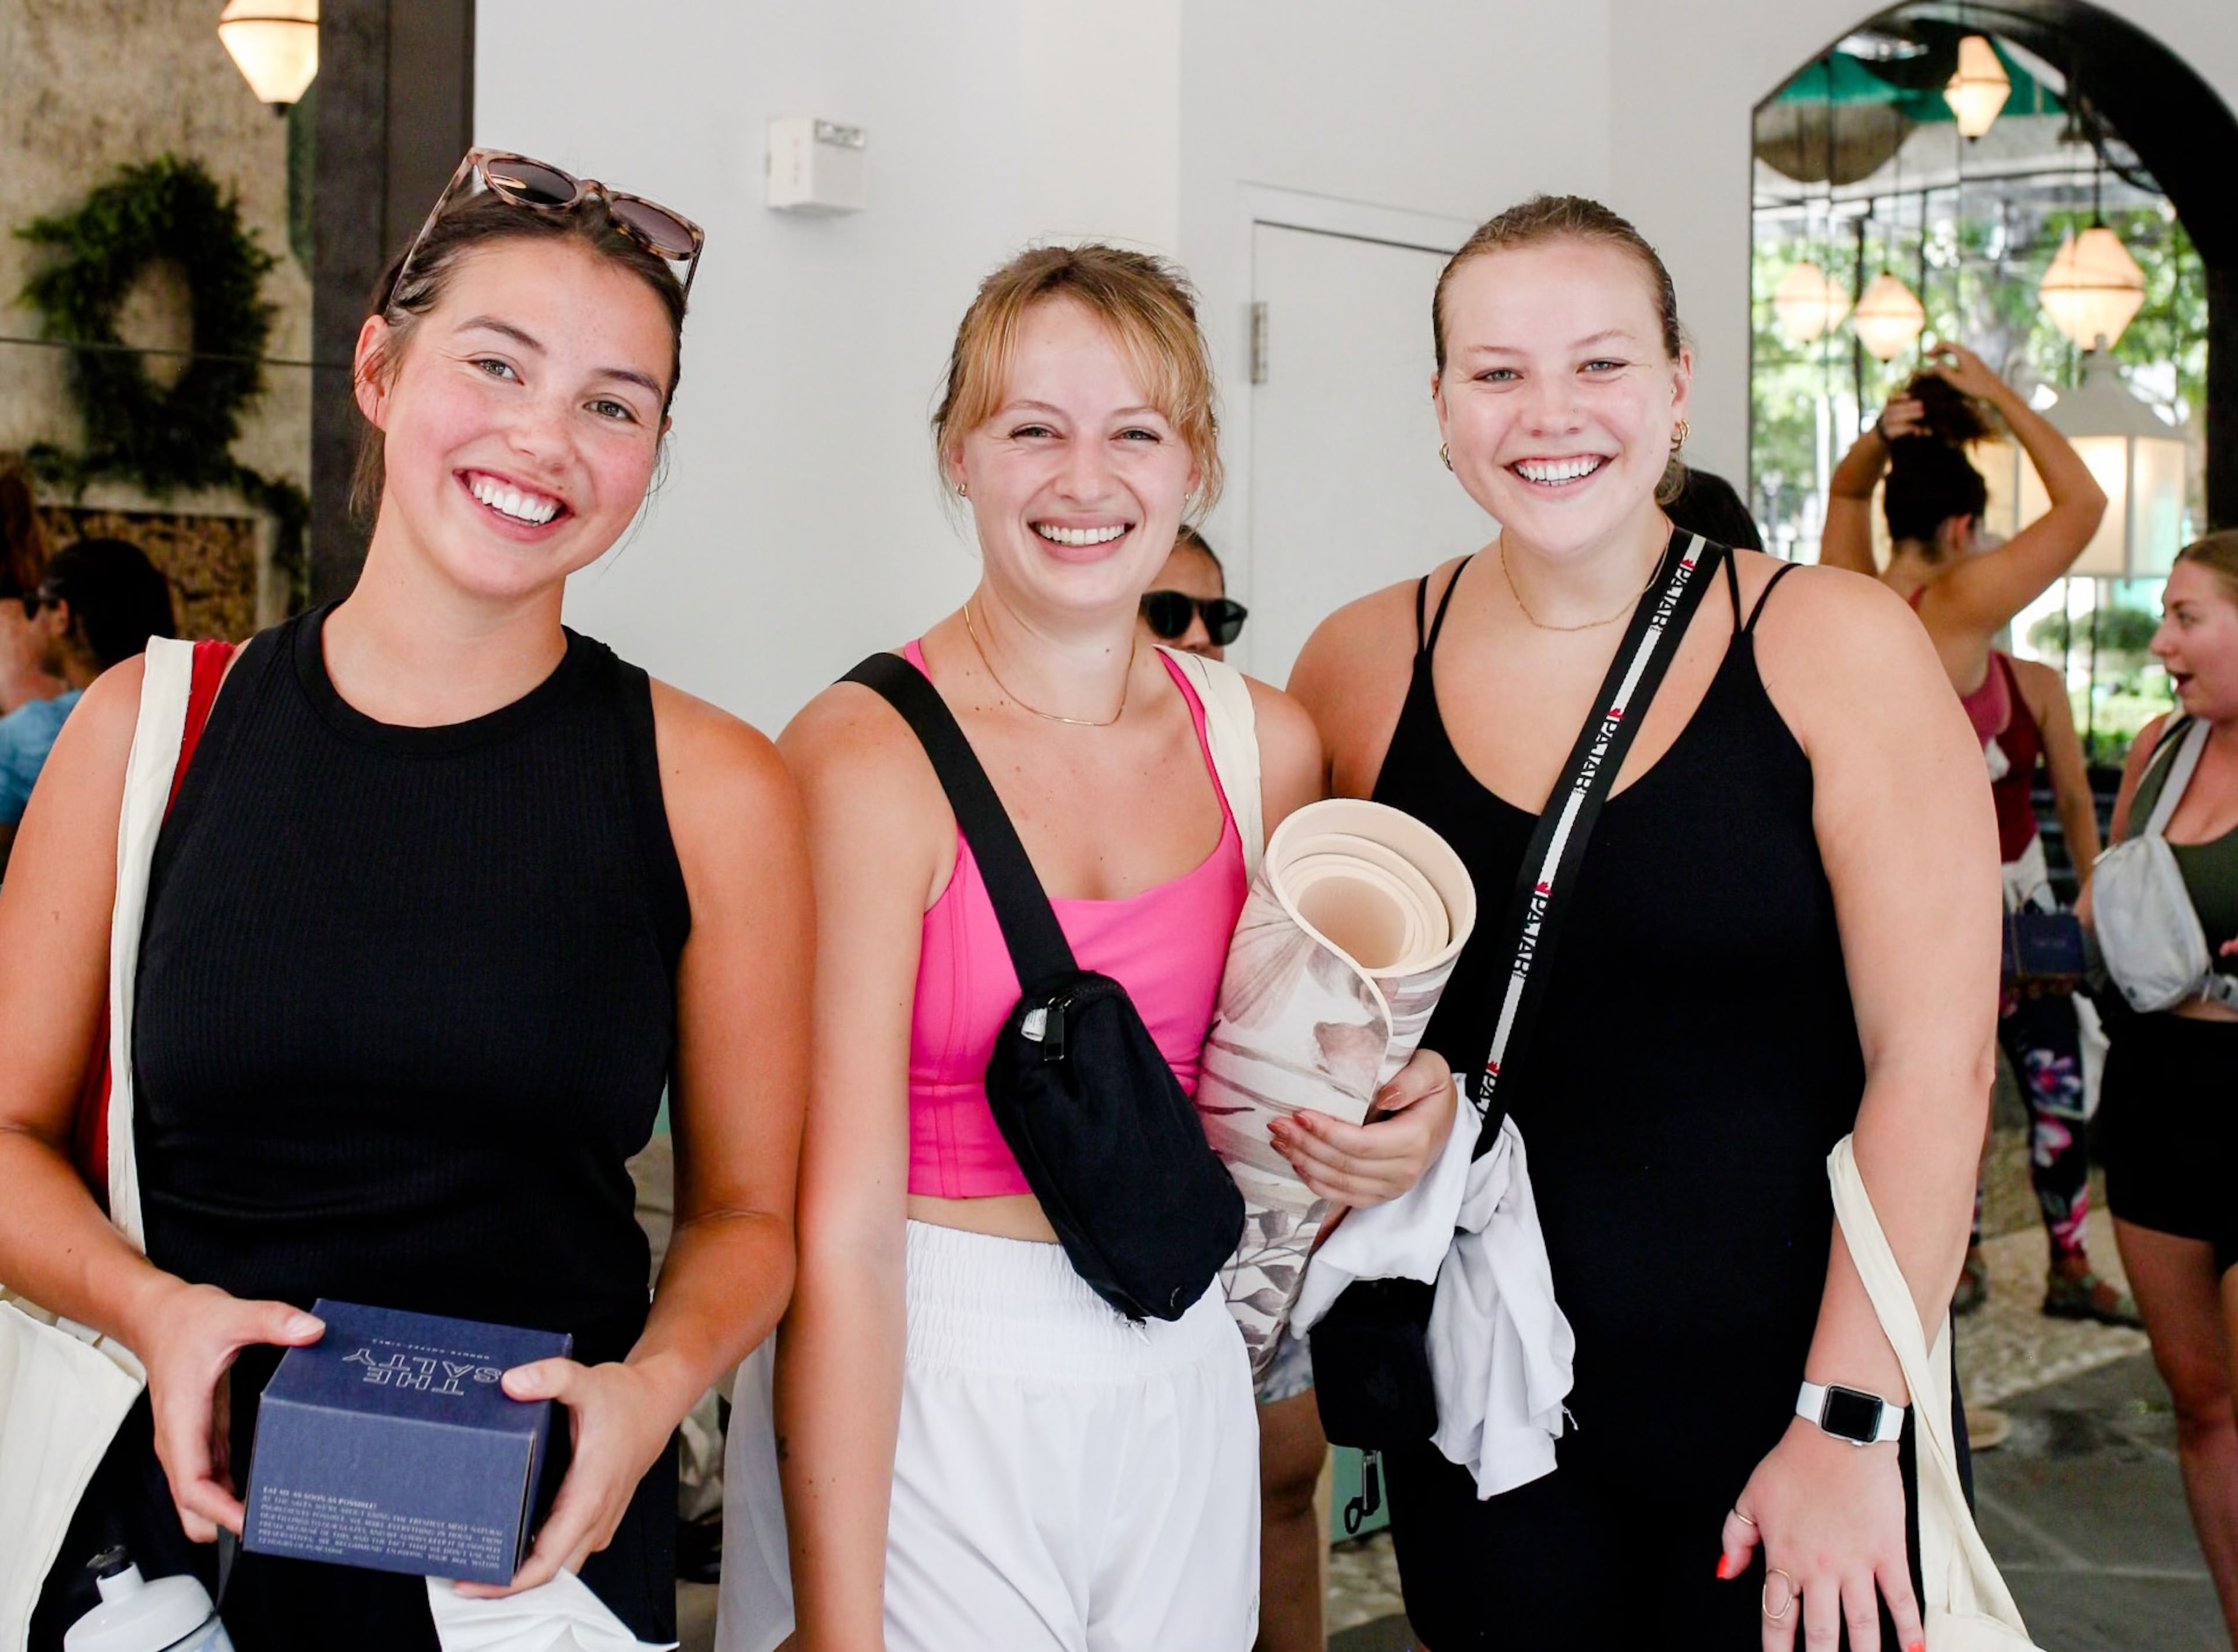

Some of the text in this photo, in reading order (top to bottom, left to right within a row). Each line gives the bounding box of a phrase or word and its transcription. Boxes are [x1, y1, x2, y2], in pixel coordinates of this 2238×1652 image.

[1650, 565, 1693, 628] PAJAR
[1575, 718, 1619, 791] PAJAR
[1513, 894, 1548, 975] PAJAR
[342, 1348, 502, 1383] SALTY
[363, 1366, 465, 1396] THE
